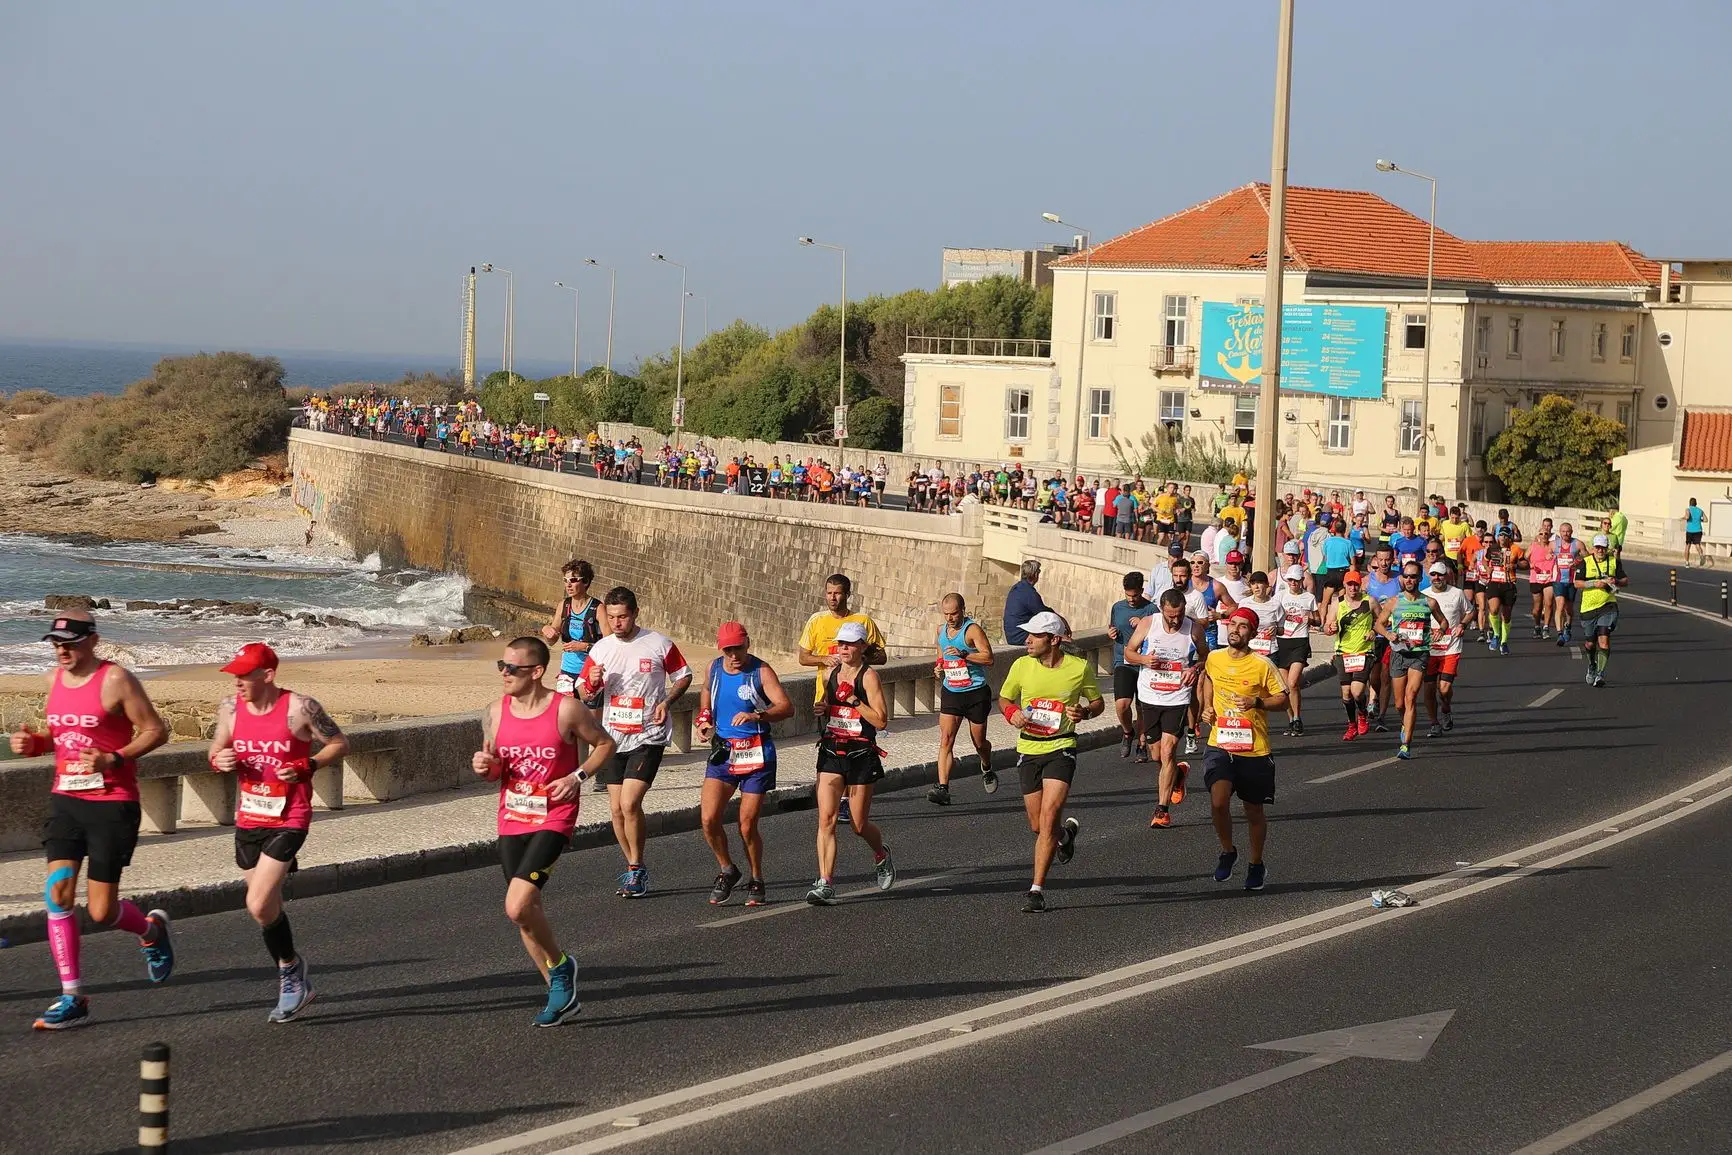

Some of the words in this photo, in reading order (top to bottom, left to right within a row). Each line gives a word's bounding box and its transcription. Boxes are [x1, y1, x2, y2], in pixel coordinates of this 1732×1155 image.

[618, 694, 632, 708] edp
[1037, 700, 1053, 711] edp
[46, 713, 100, 728] ROB
[1226, 718, 1240, 728] edp
[233, 740, 291, 753] GLYN
[735, 739, 751, 749] edp
[499, 746, 556, 760] CRAIG
[252, 782, 271, 797] edp
[515, 781, 533, 797] edp
